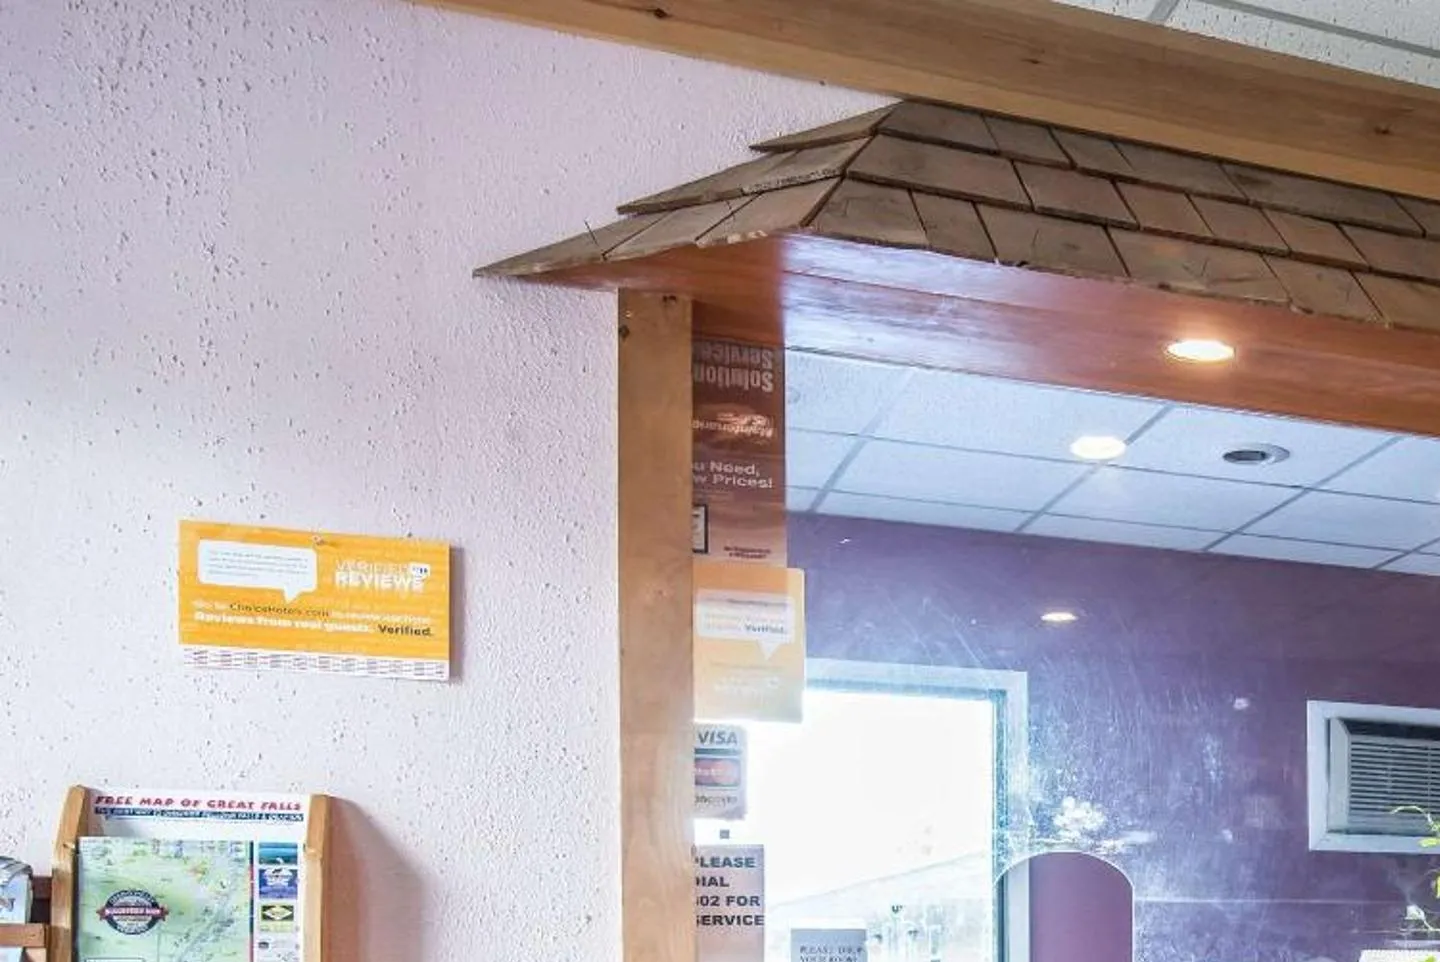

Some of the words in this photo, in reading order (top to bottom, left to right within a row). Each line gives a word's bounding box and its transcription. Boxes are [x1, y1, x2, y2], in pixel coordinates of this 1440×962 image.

[699, 730, 738, 745] VISA
[95, 795, 134, 806] FREE
[139, 798, 174, 807] MAP
[181, 798, 201, 808] OF
[695, 895, 720, 907] 02
[726, 895, 761, 907] FOR
